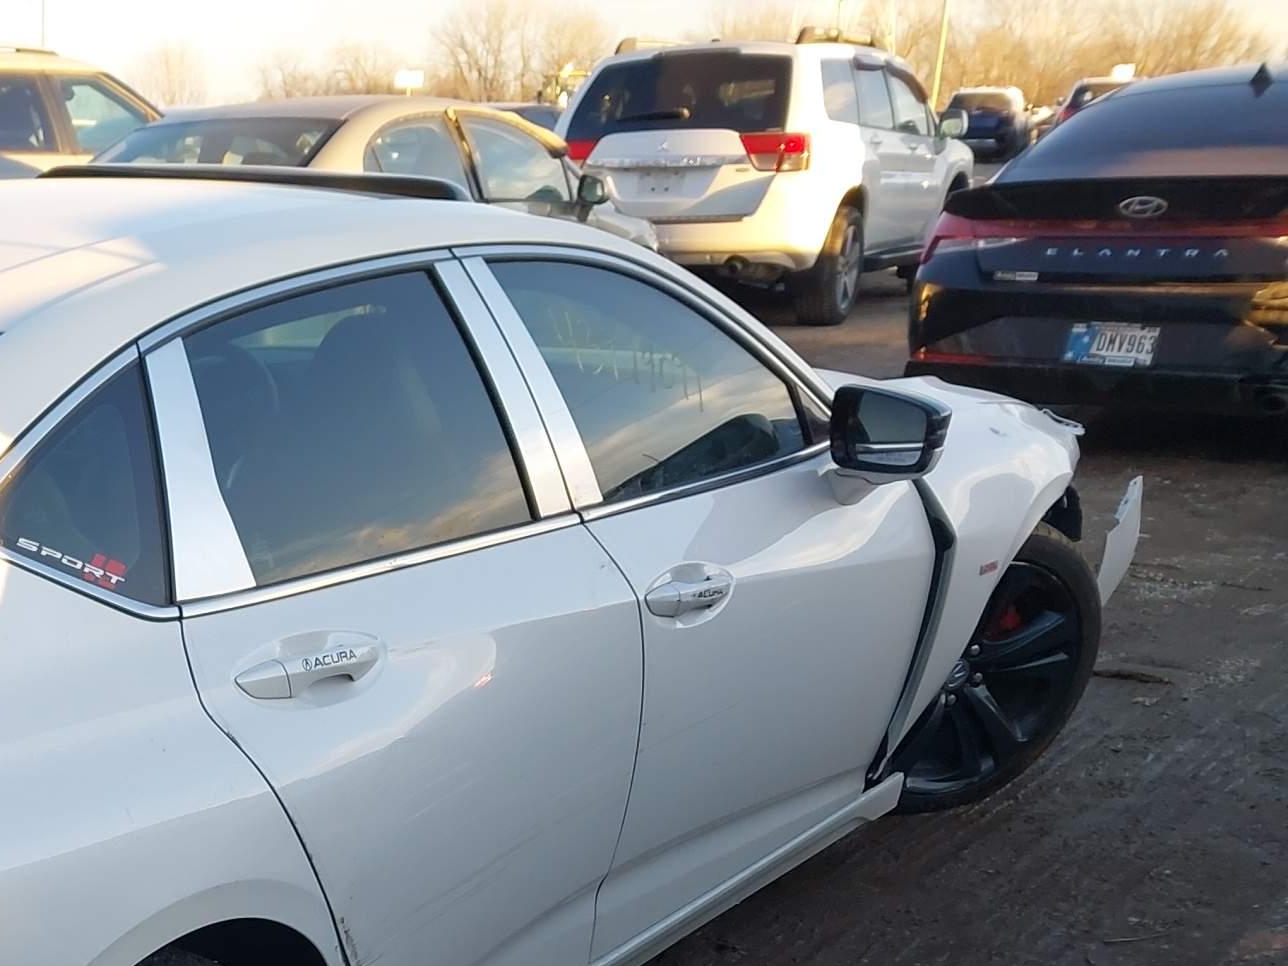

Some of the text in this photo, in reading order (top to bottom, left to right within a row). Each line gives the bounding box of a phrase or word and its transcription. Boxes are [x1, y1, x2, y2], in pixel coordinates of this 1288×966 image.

[1046, 248, 1229, 257] ELANTRA
[16, 537, 126, 584] SPORT
[313, 649, 357, 669] ACURA
